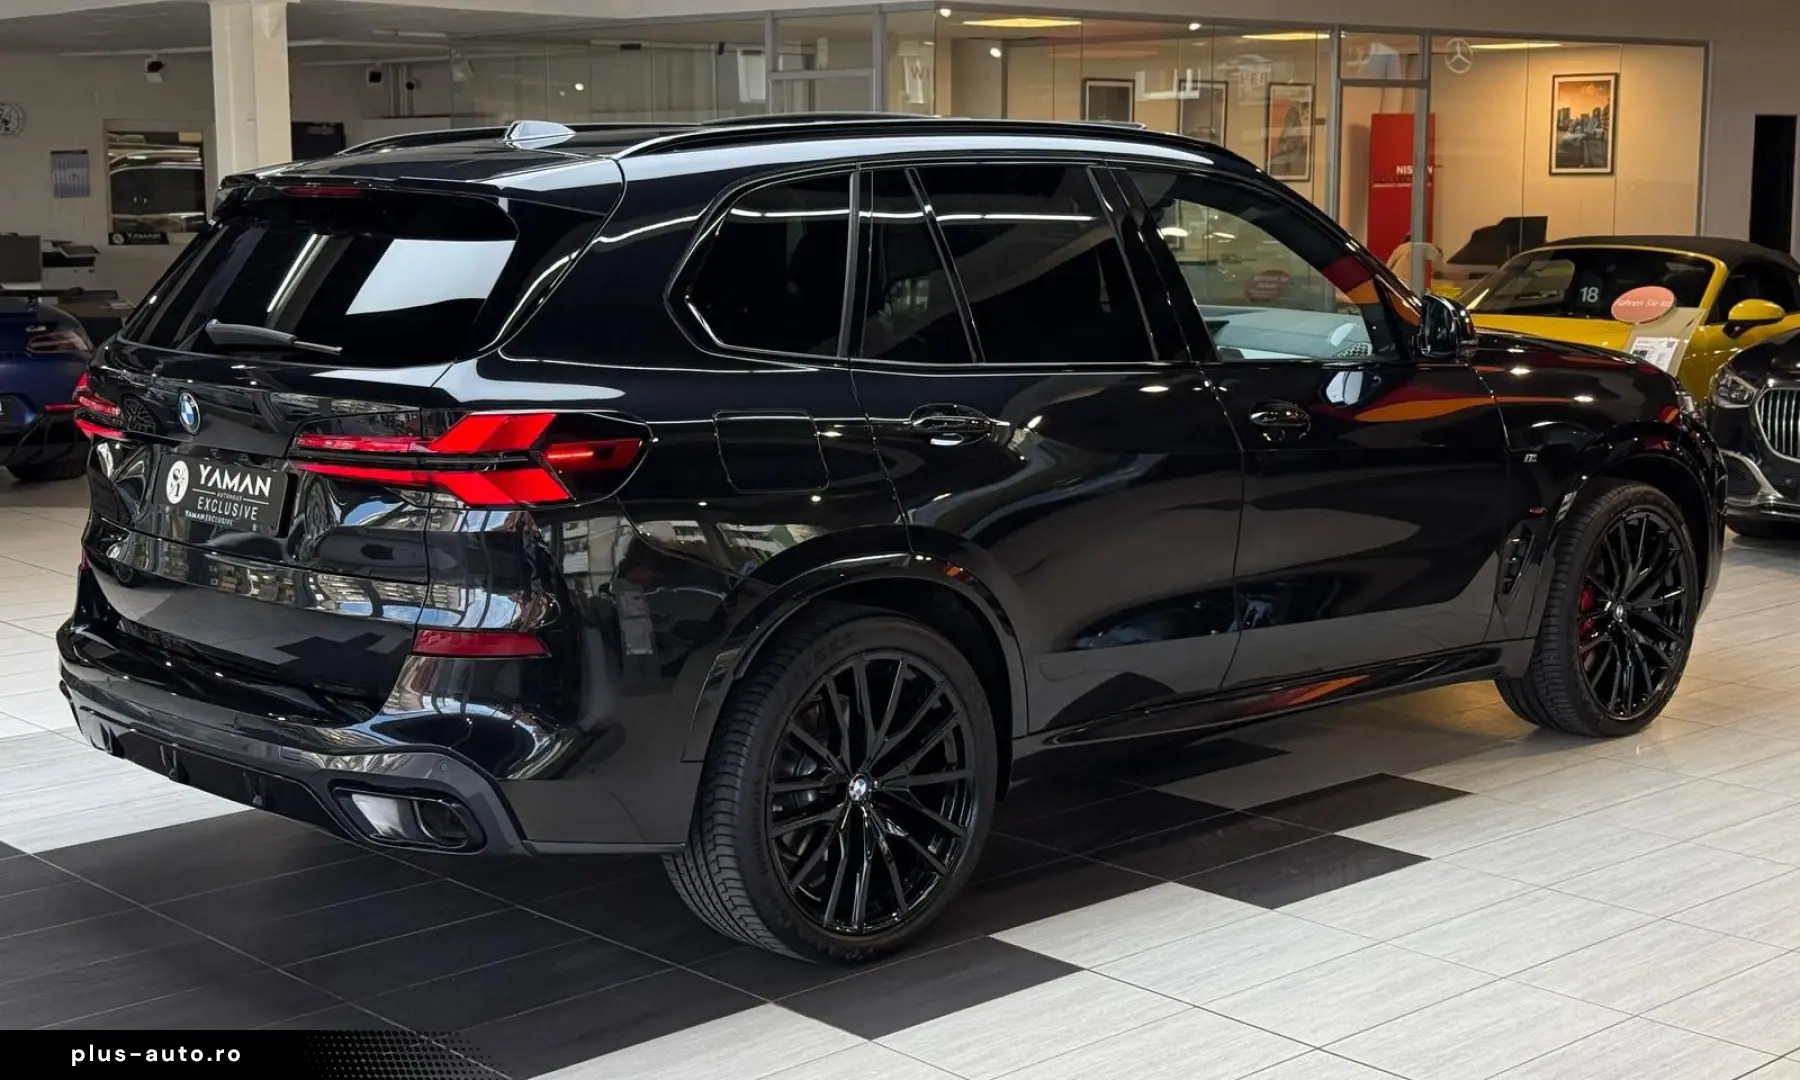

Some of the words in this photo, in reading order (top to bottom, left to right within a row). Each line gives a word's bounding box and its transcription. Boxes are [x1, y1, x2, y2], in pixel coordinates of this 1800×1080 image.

[1396, 165, 1433, 174] NISN
[1580, 286, 1599, 303] 18
[199, 464, 272, 497] YAMAN
[197, 496, 259, 521] EXCLUSIVE
